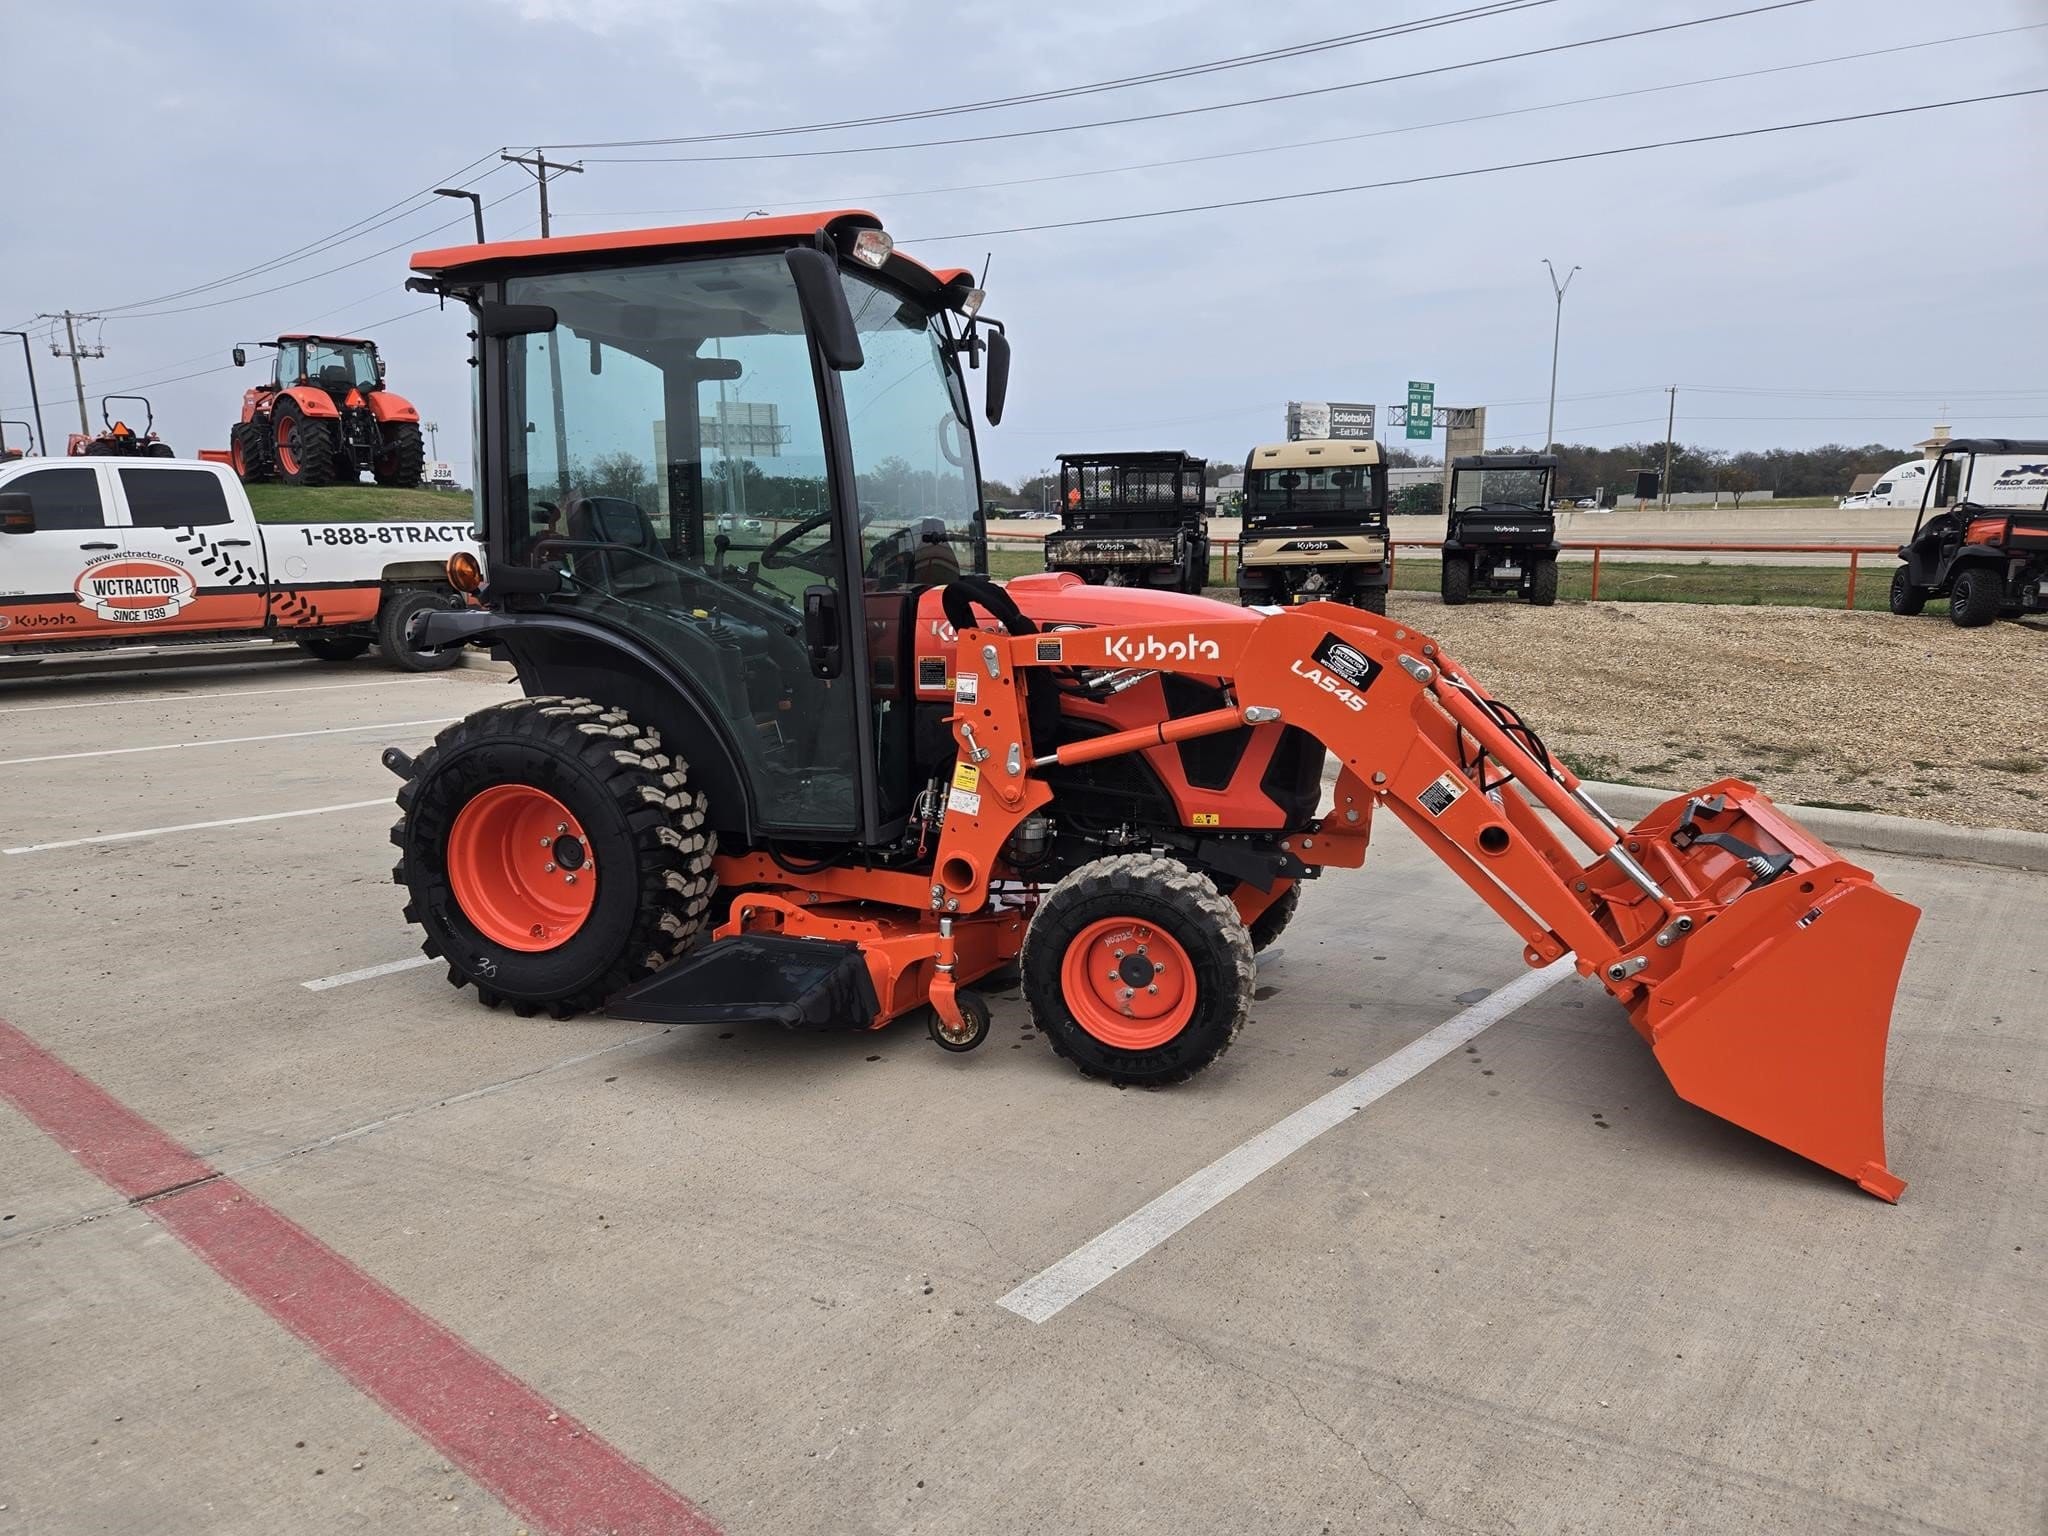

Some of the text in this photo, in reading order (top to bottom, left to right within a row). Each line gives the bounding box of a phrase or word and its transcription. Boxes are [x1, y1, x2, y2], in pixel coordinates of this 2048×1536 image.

[1334, 412, 1370, 425] Schlotzsky's
[433, 470, 452, 478] 333A
[1297, 541, 1328, 549] Kubota
[85, 550, 184, 567] www.wctractor.com
[93, 578, 180, 596] WCTRACTOR
[15, 612, 76, 627] Kubota
[113, 607, 166, 621] SINCE 1939
[1105, 633, 1219, 662] Kubota
[1320, 658, 1360, 687] WCTRACTOR.COM
[1291, 659, 1368, 711] LA545
